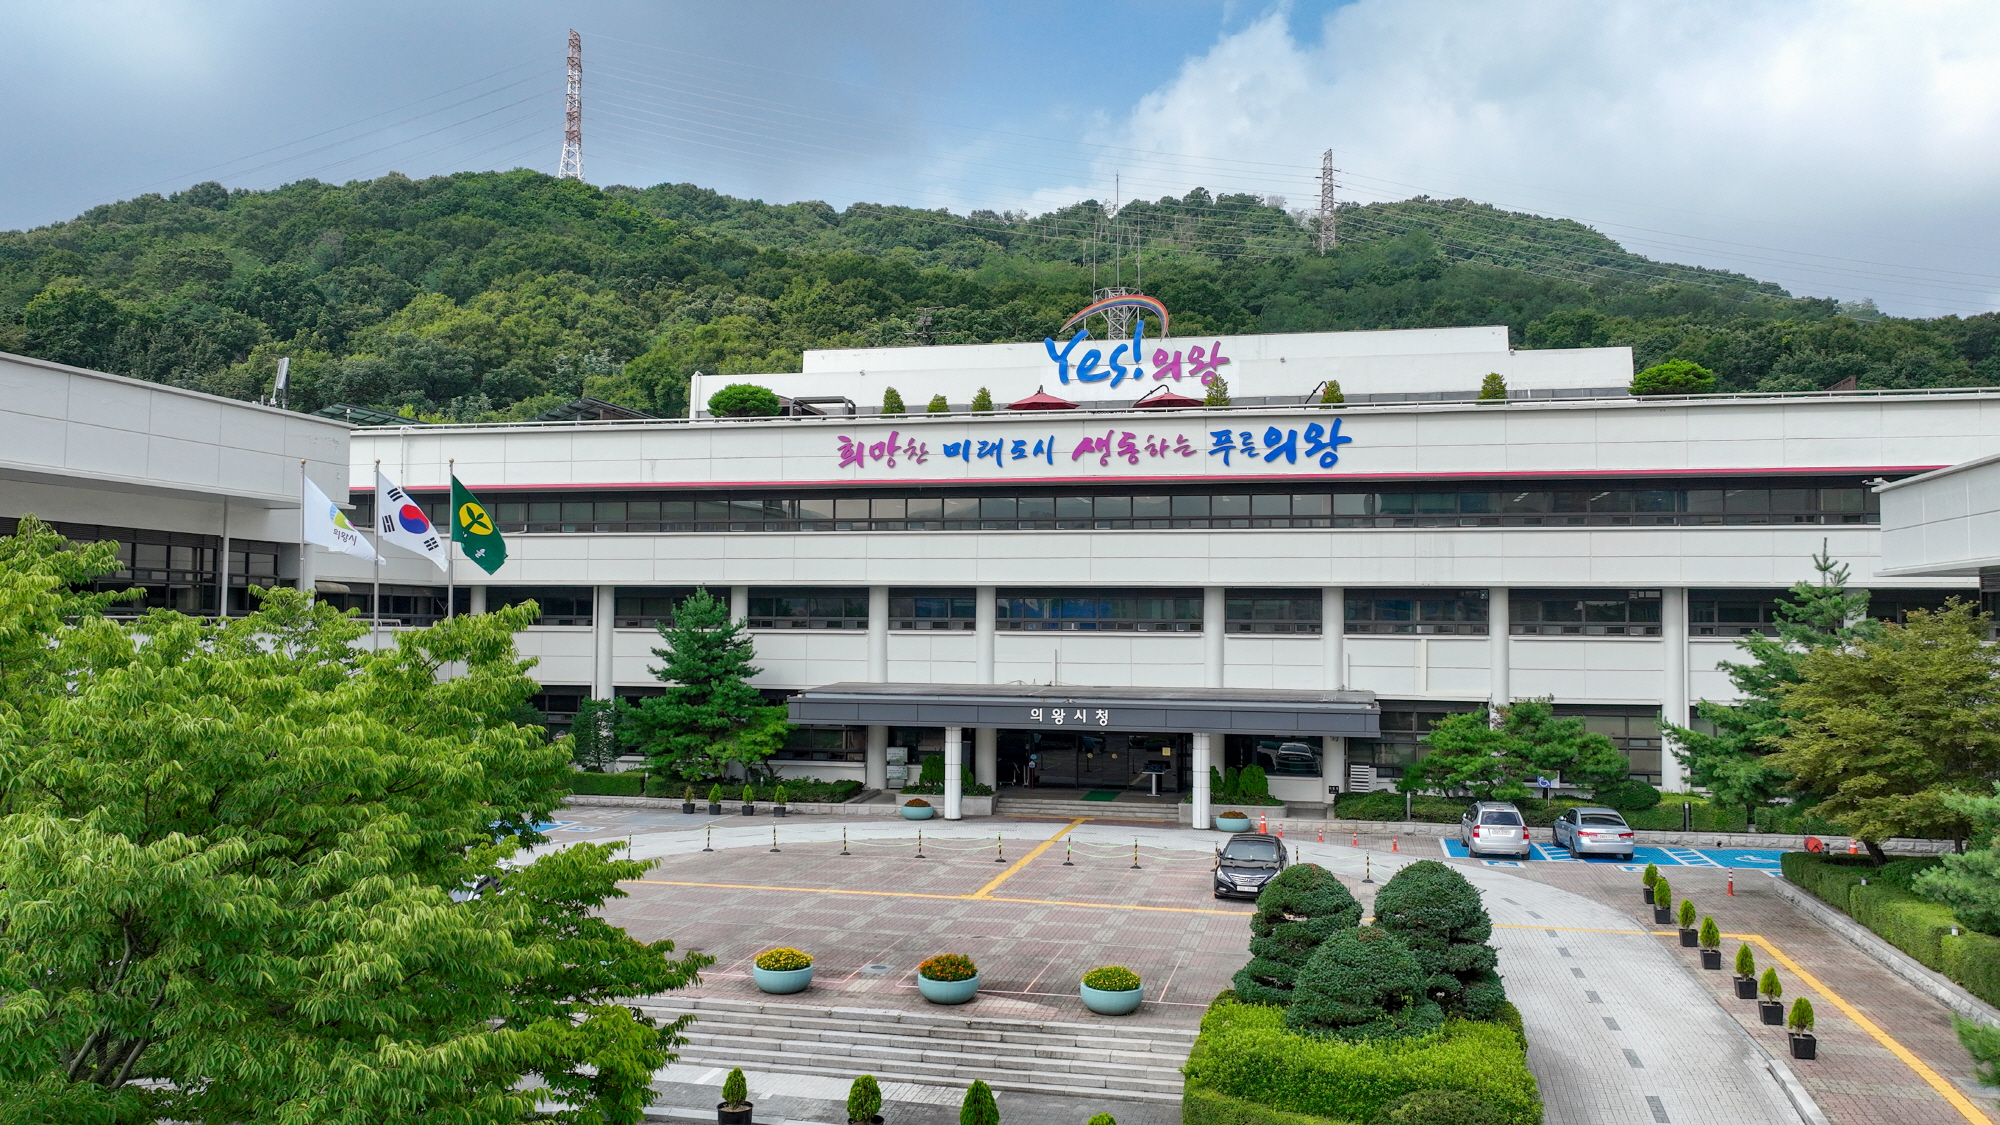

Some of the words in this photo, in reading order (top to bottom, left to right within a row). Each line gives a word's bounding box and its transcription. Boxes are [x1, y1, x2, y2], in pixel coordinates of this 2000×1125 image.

[1043, 319, 1145, 388] Yes!
[1152, 340, 1230, 385] 의왕
[837, 430, 929, 468] 희망찬
[942, 435, 1055, 468] 미래도시
[1071, 429, 1197, 466] 생동하는
[333, 528, 357, 546] 의왕시
[1029, 708, 1109, 727] 의왕시청
